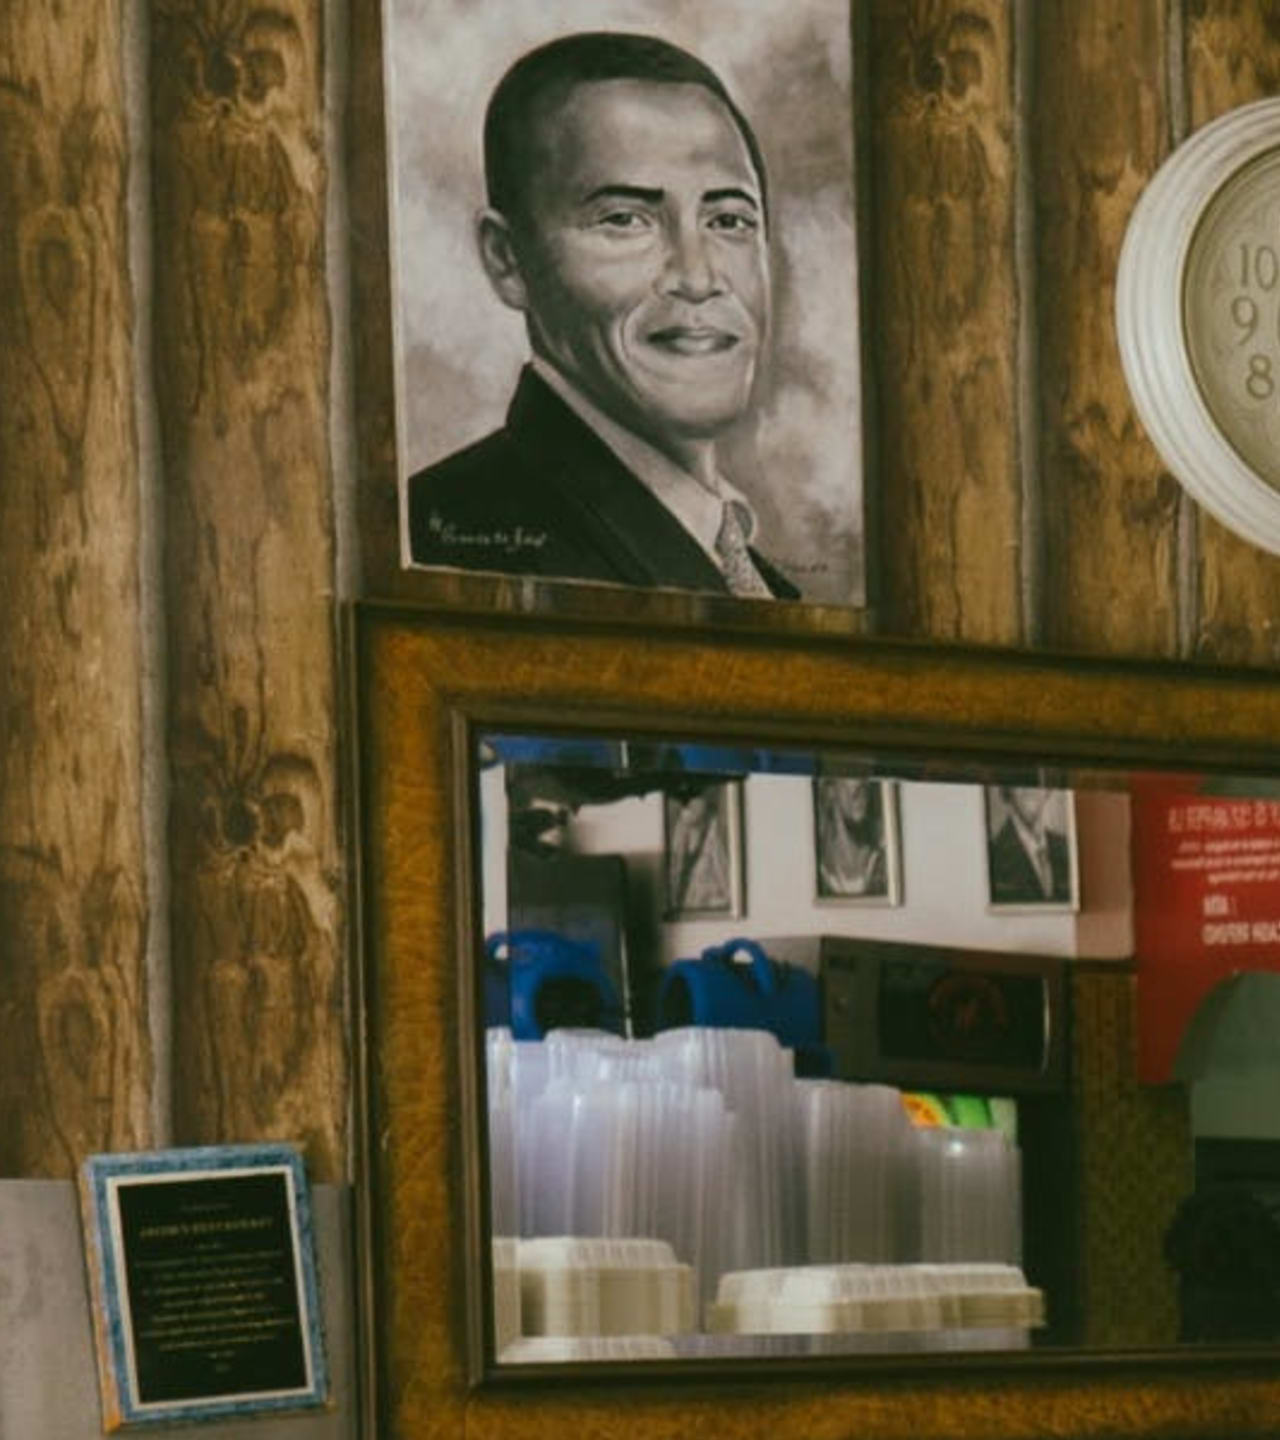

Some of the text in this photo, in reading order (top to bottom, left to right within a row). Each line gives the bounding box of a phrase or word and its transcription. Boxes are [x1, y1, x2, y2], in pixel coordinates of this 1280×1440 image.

[1240, 242, 1280, 292] 10
[1230, 296, 1259, 346] 9
[1245, 354, 1275, 400] 8
